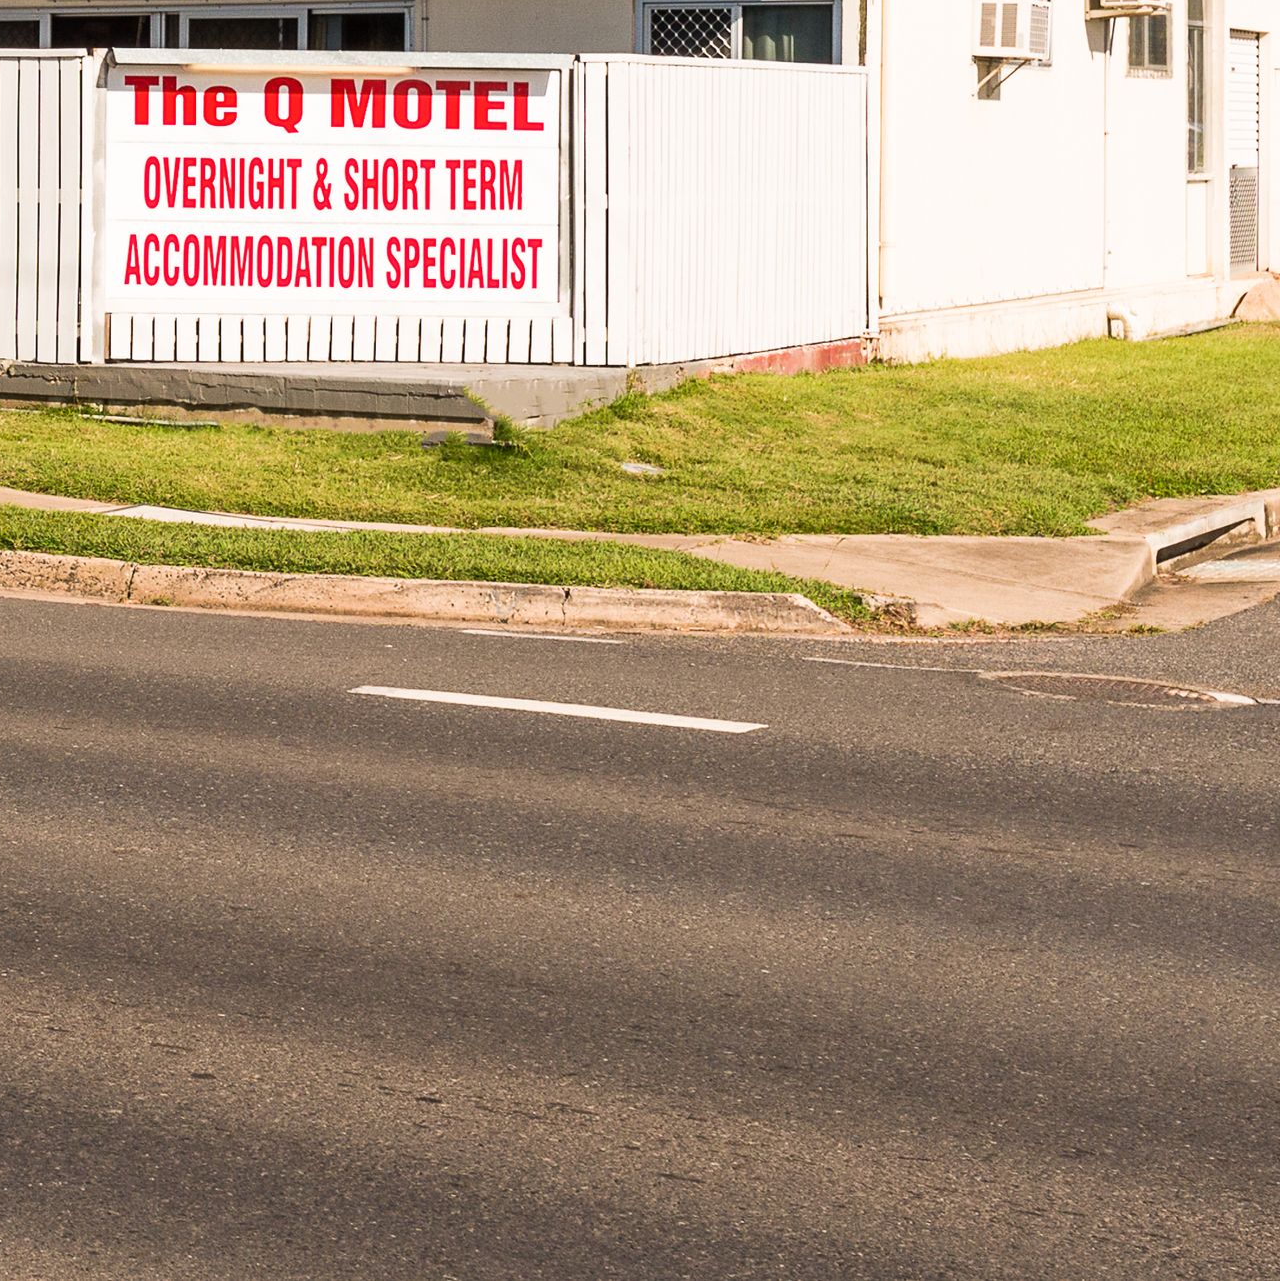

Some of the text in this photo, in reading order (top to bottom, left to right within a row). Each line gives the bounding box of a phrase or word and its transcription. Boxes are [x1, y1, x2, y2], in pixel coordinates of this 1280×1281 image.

[124, 75, 545, 134] The Q MOTEL
[143, 156, 523, 211] OVERNIGHT & SHORT TERM
[124, 233, 543, 289] ACCOMMODATION SPECIALIST
